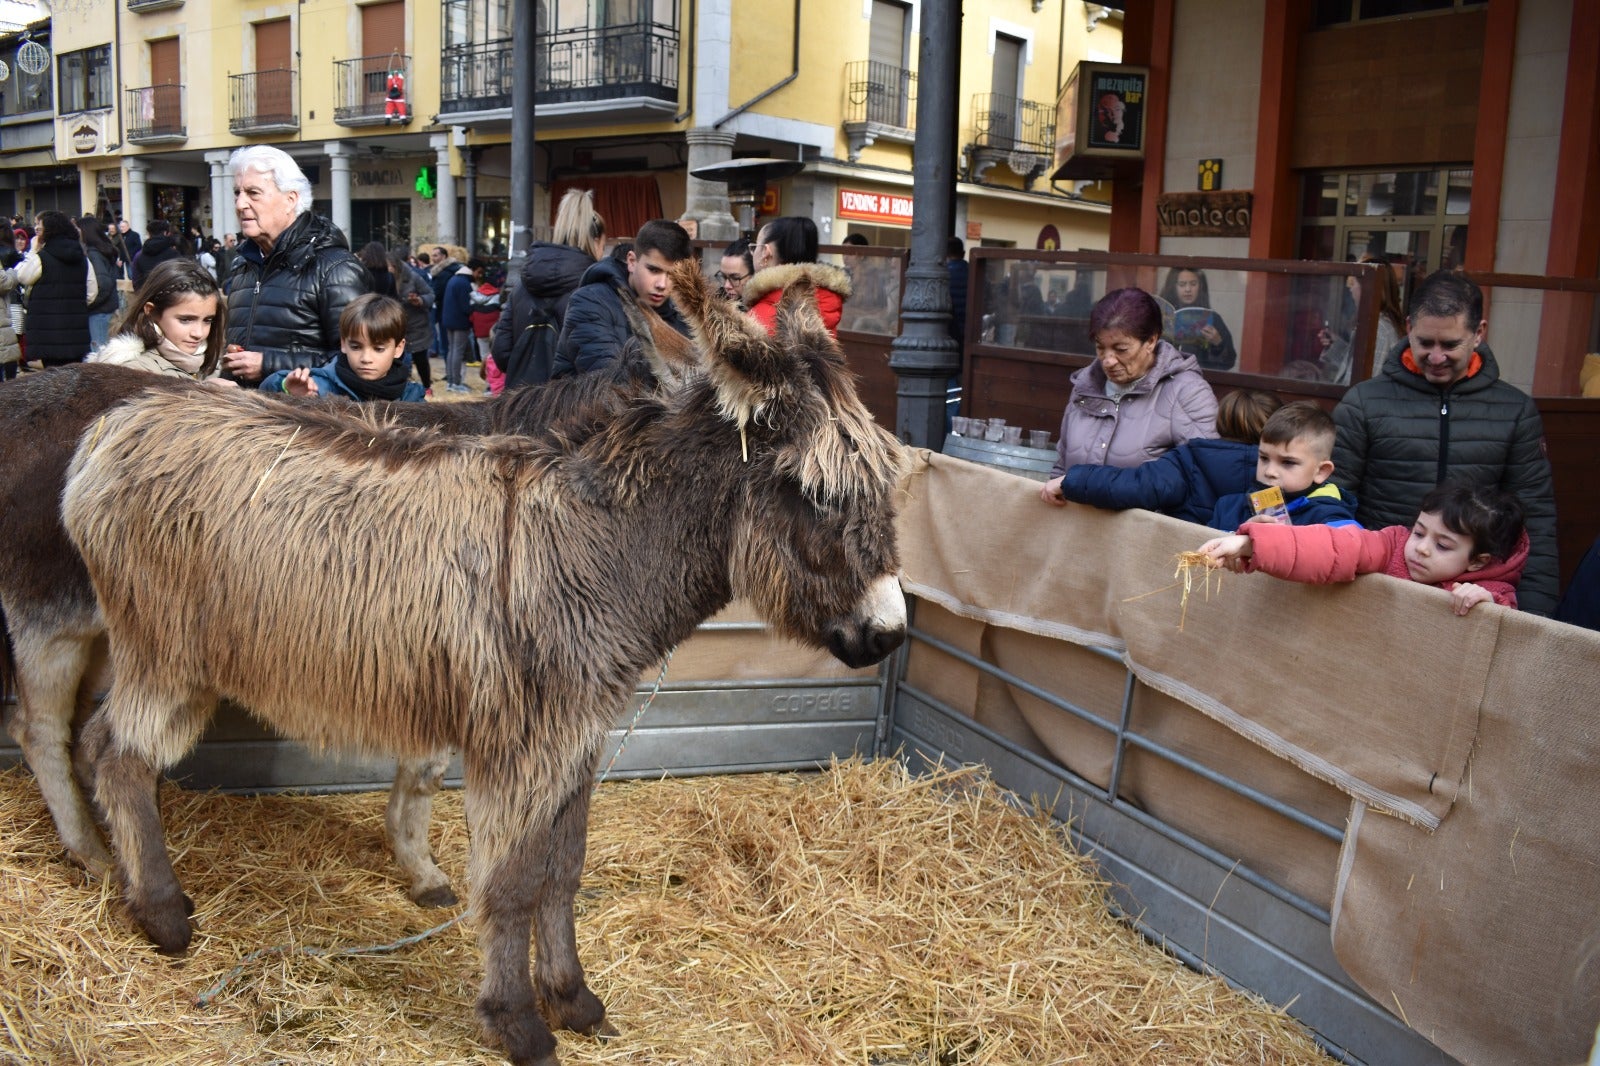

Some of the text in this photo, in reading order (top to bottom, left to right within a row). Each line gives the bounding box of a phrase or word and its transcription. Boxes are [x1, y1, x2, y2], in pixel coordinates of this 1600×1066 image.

[1097, 77, 1143, 93] mezquita
[1125, 90, 1142, 103] bar
[841, 191, 878, 213] VENDING
[879, 196, 890, 214] 24
[1157, 199, 1250, 227] Vinoteca
[771, 691, 853, 714] COPELE
